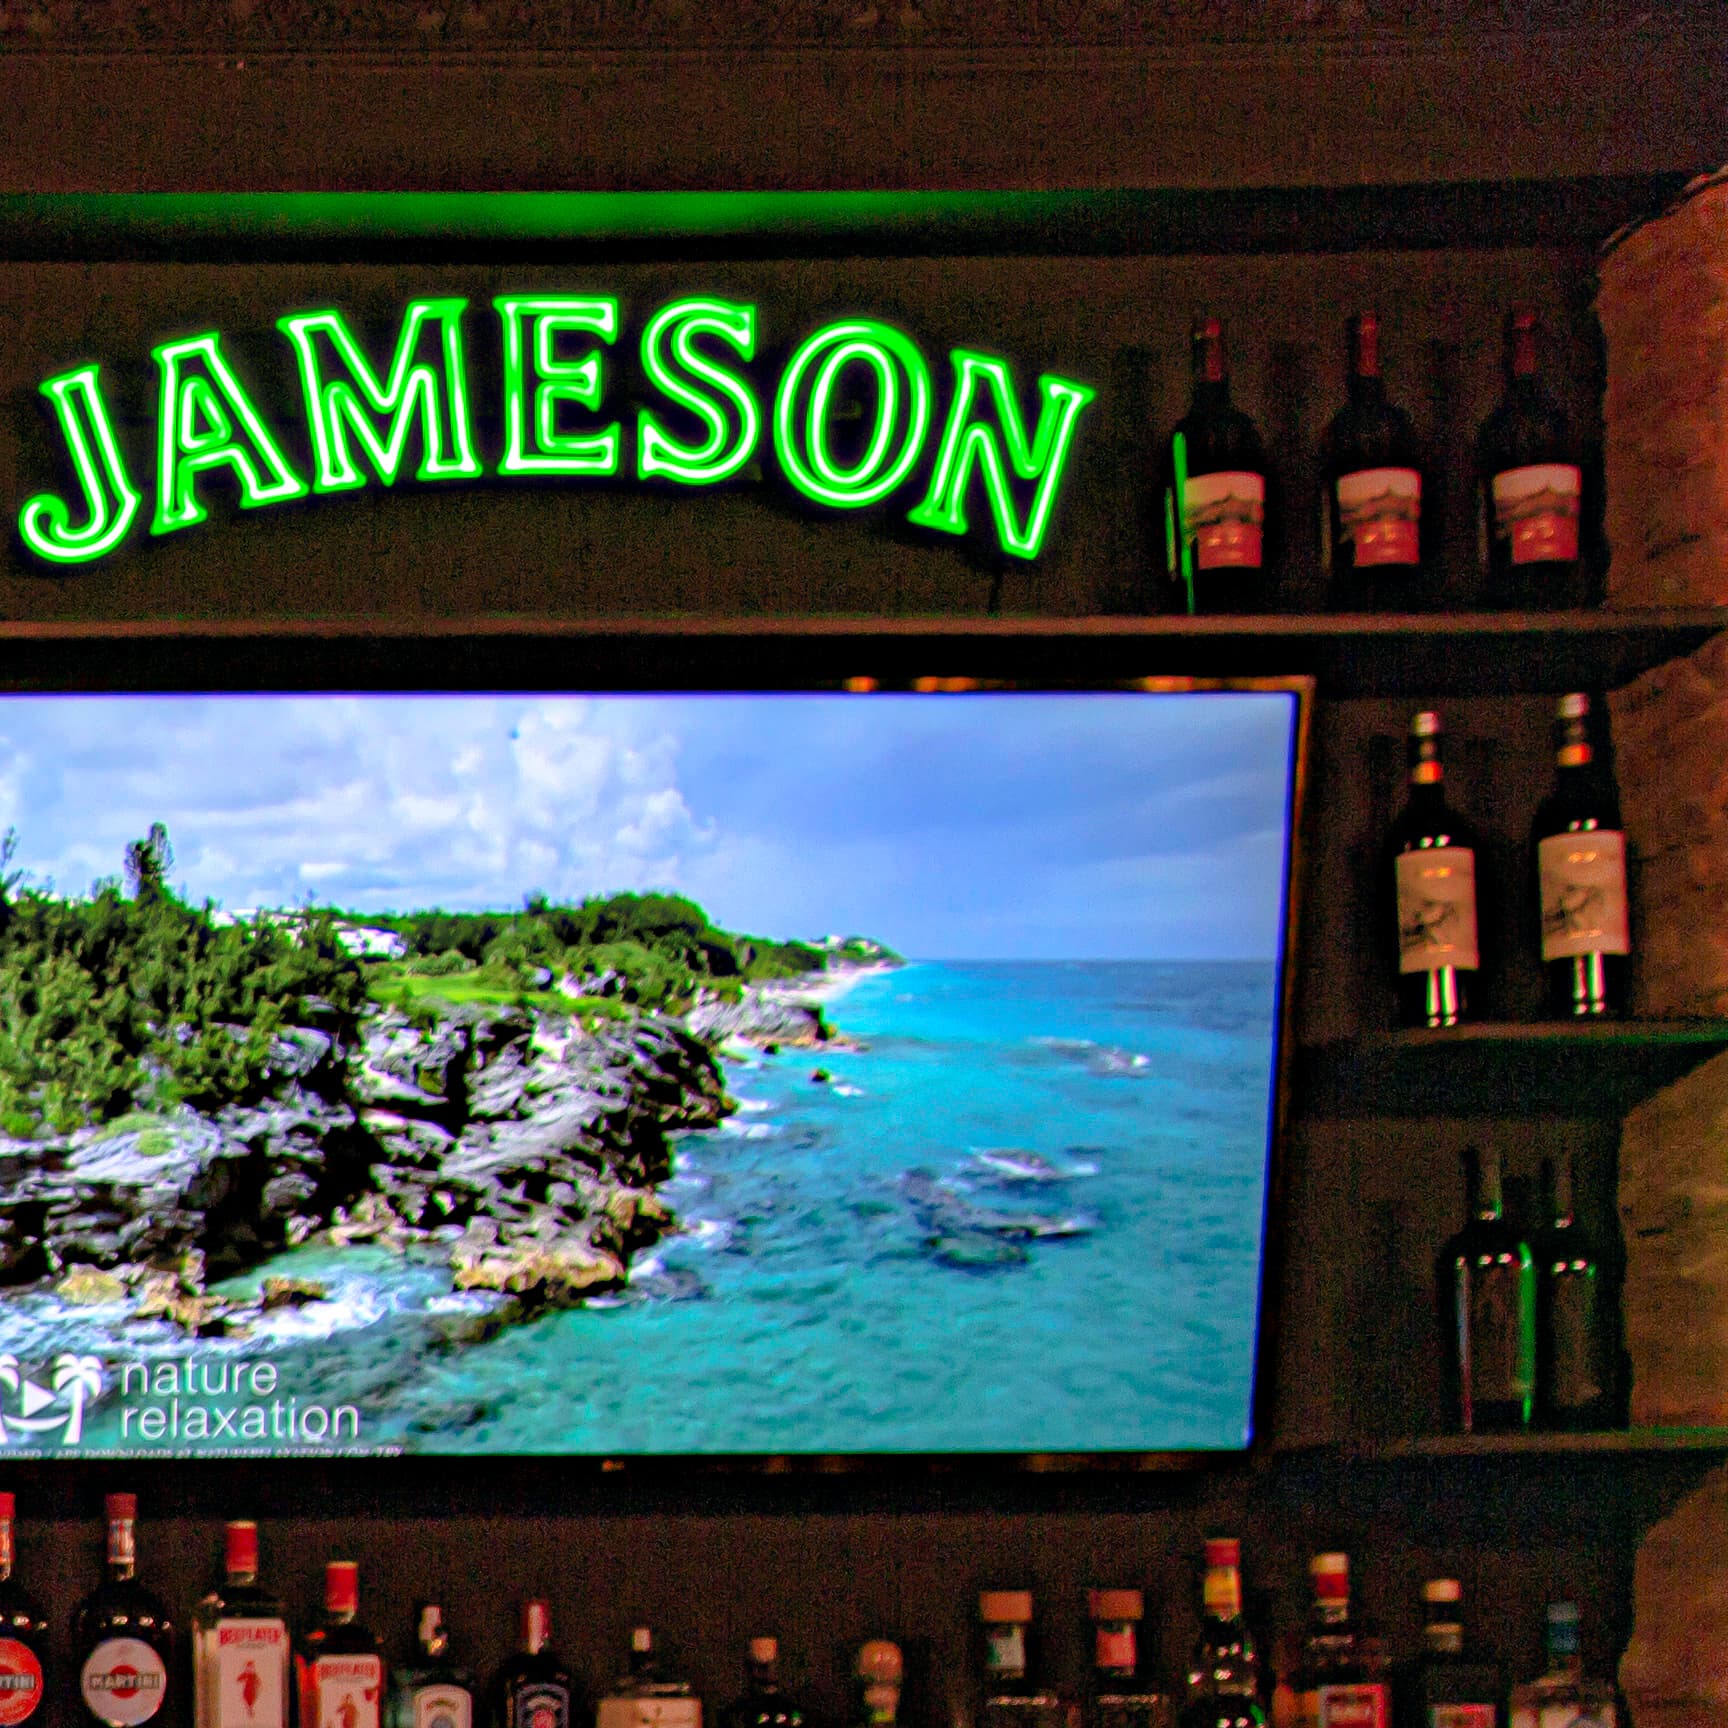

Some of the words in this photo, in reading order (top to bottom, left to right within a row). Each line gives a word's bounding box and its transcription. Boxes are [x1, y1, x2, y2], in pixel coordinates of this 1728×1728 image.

[18, 293, 1095, 564] JAMESON
[121, 1360, 279, 1395] nature
[121, 1398, 360, 1440] relaxation
[89, 1673, 161, 1692] MARTINI
